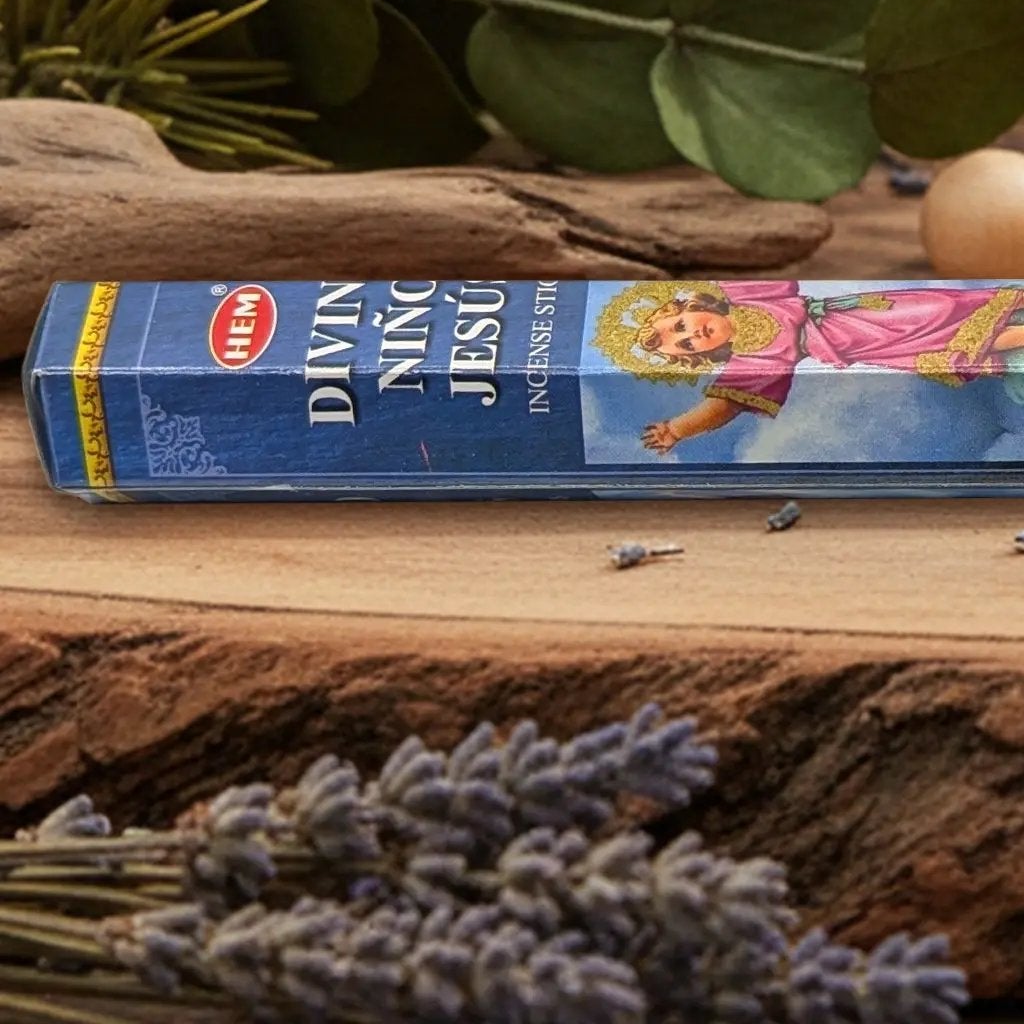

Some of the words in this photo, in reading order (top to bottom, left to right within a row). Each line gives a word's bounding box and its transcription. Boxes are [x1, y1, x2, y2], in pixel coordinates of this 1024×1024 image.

[224, 293, 261, 360] HEM
[305, 281, 365, 427] DIVIN
[445, 281, 507, 406] JESÚ
[526, 320, 553, 414] INCENSE
